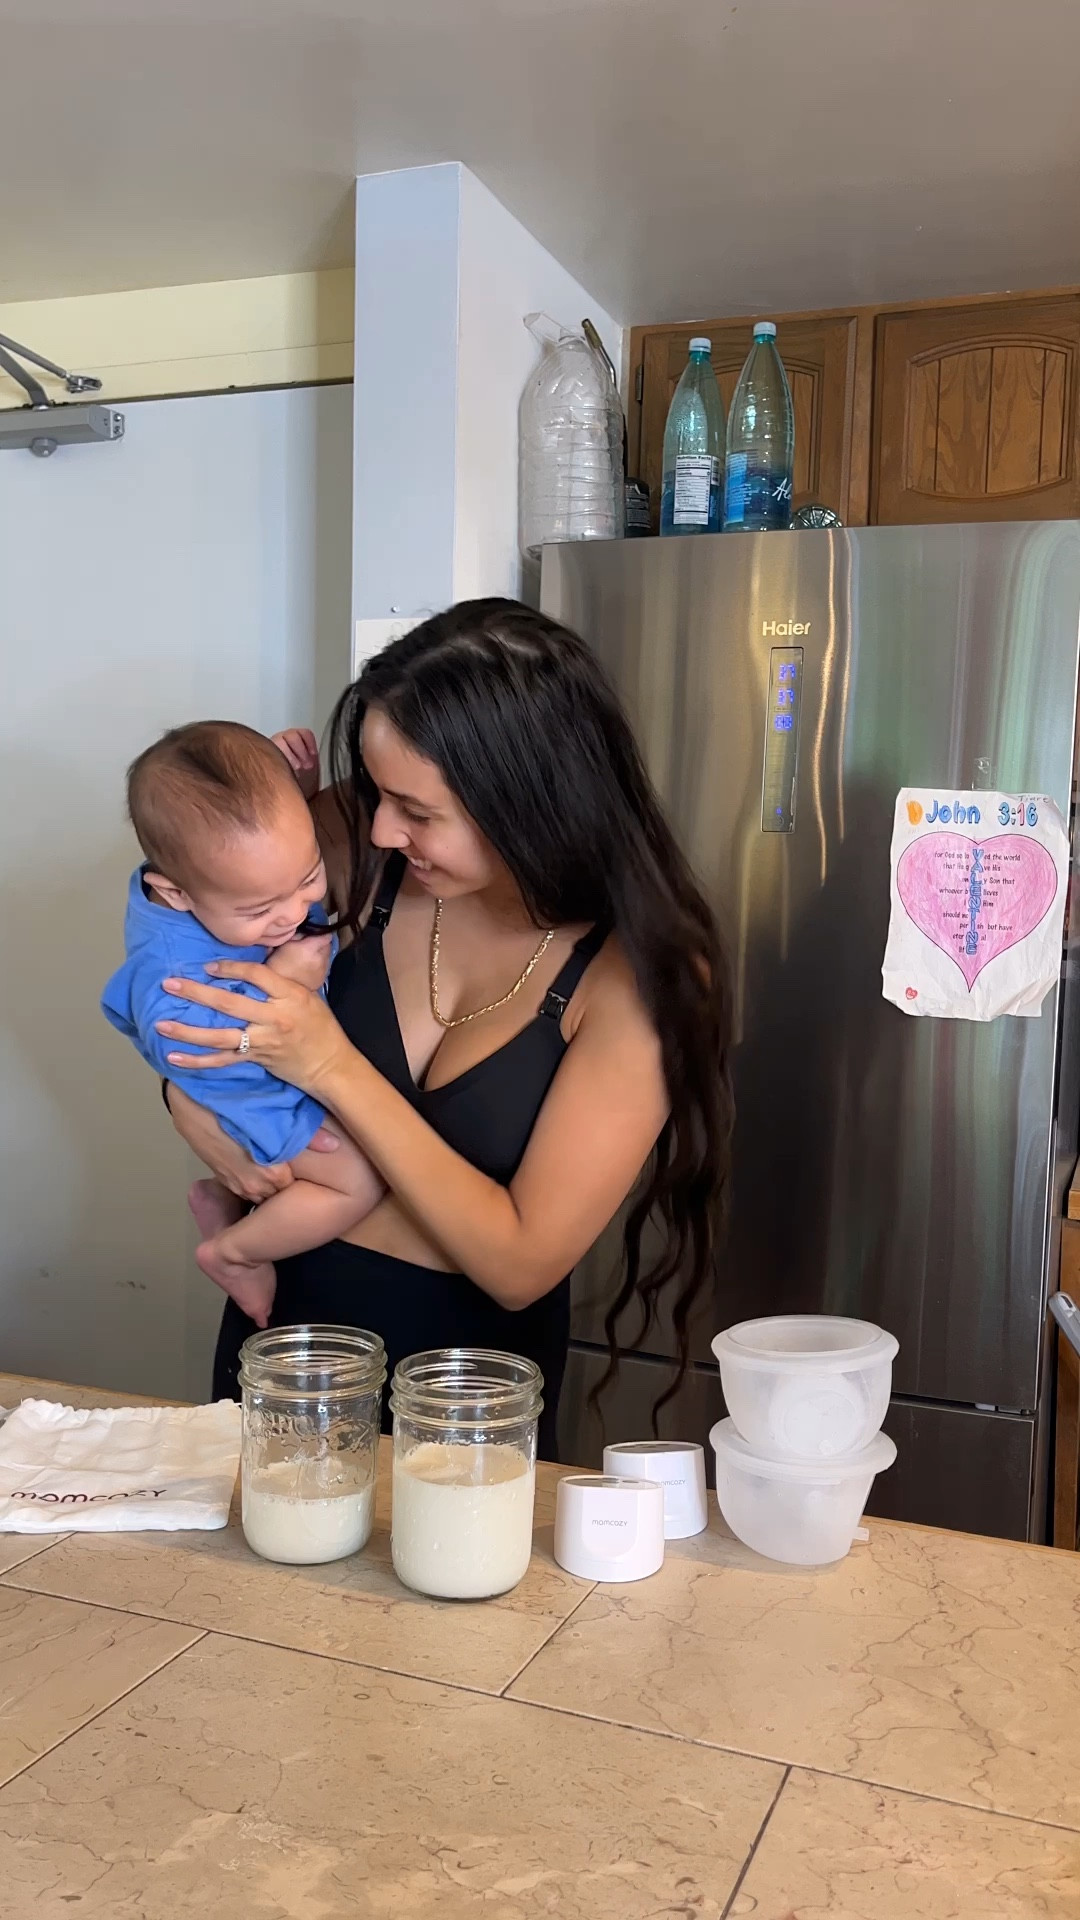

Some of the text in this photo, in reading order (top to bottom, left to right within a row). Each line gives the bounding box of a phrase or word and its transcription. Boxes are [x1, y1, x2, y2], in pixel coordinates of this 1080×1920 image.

[762, 619, 811, 636] Haier
[925, 799, 1038, 827] John 3:16
[1002, 877, 1015, 885] that
[998, 923, 1013, 931] have
